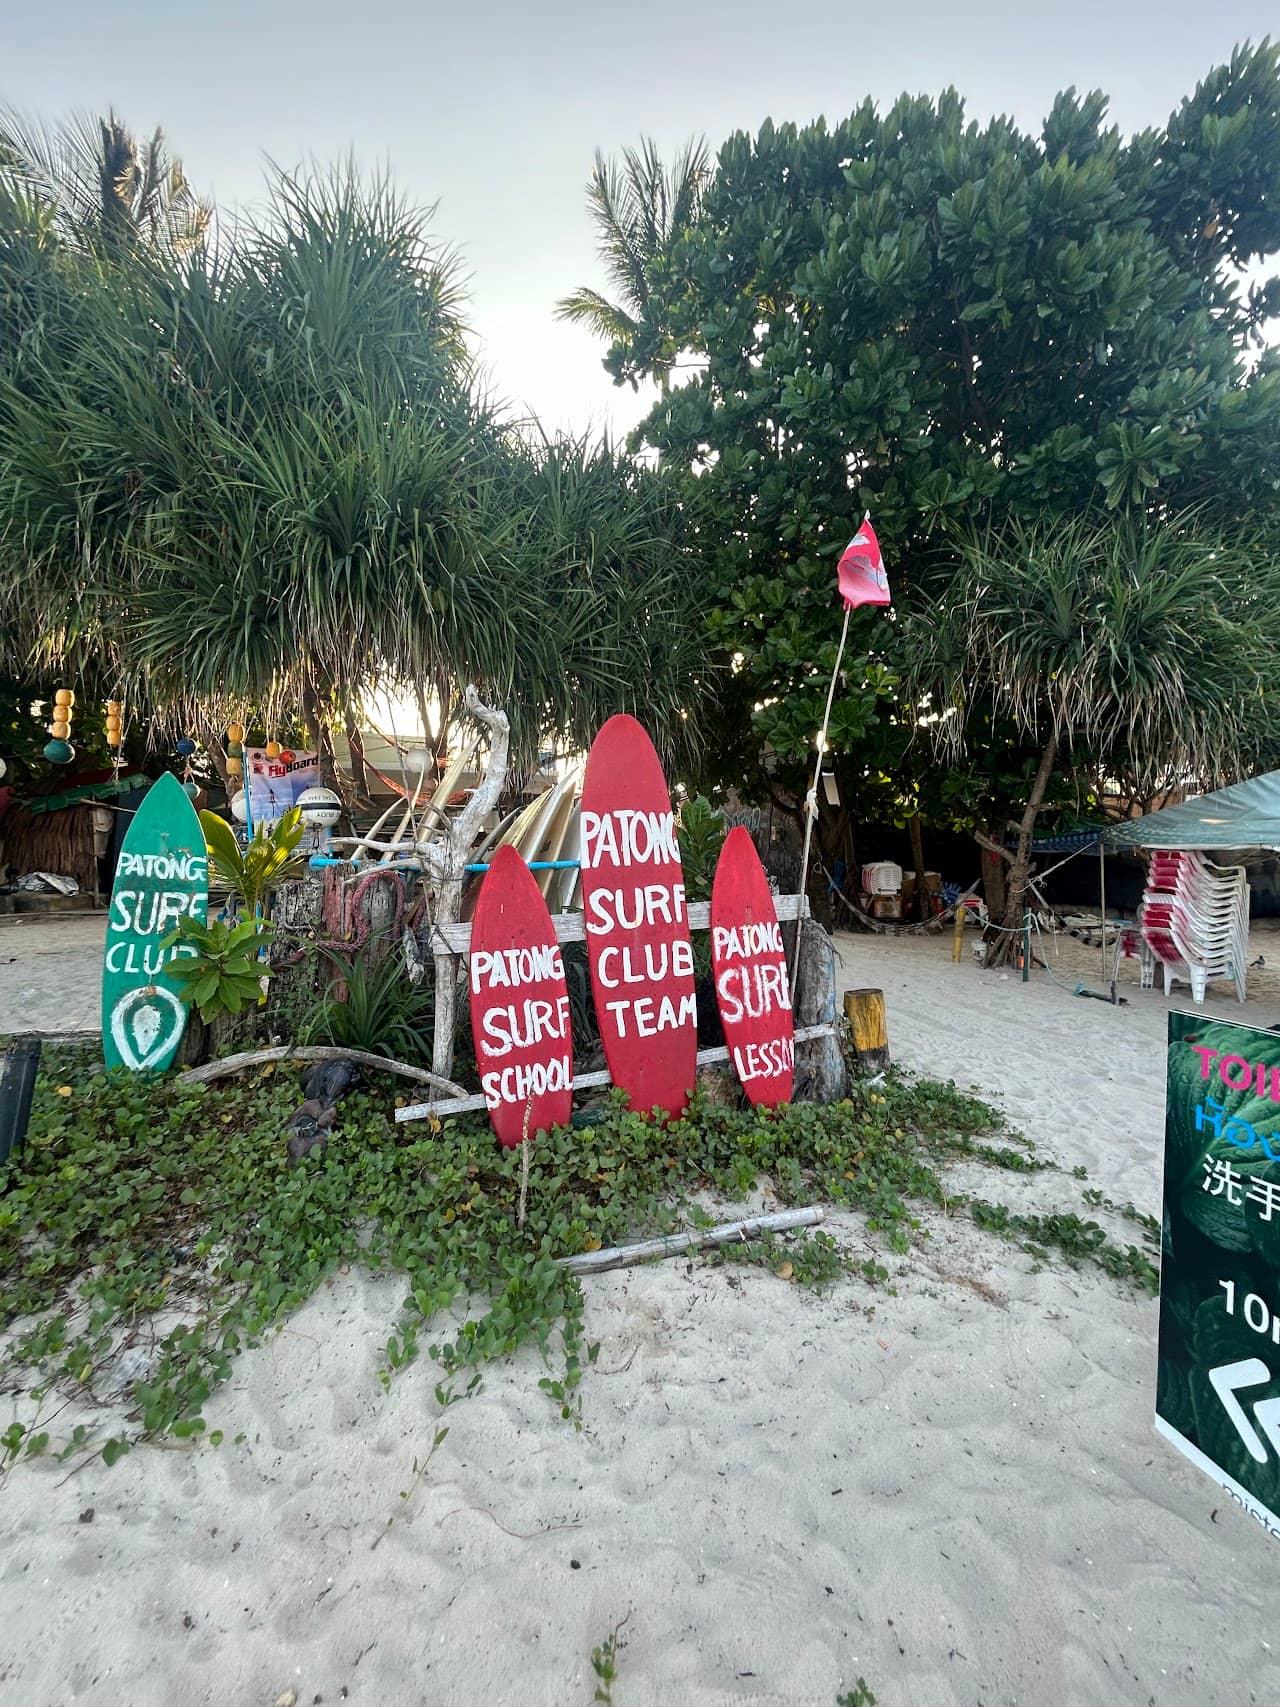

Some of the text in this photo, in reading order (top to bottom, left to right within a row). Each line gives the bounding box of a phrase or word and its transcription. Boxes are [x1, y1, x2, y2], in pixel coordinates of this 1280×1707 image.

[580, 810, 681, 869] PATONG
[116, 852, 207, 881] PATONG
[111, 890, 209, 936] SURF
[586, 884, 686, 935] SURF
[598, 940, 694, 988] CLUB
[712, 921, 784, 961] PATONG
[471, 944, 565, 995] PATONG
[480, 996, 569, 1057] SURF
[606, 993, 698, 1038] TEAM
[481, 1055, 573, 1111] SCHOOL
[1201, 1153, 1280, 1222] 洗手
